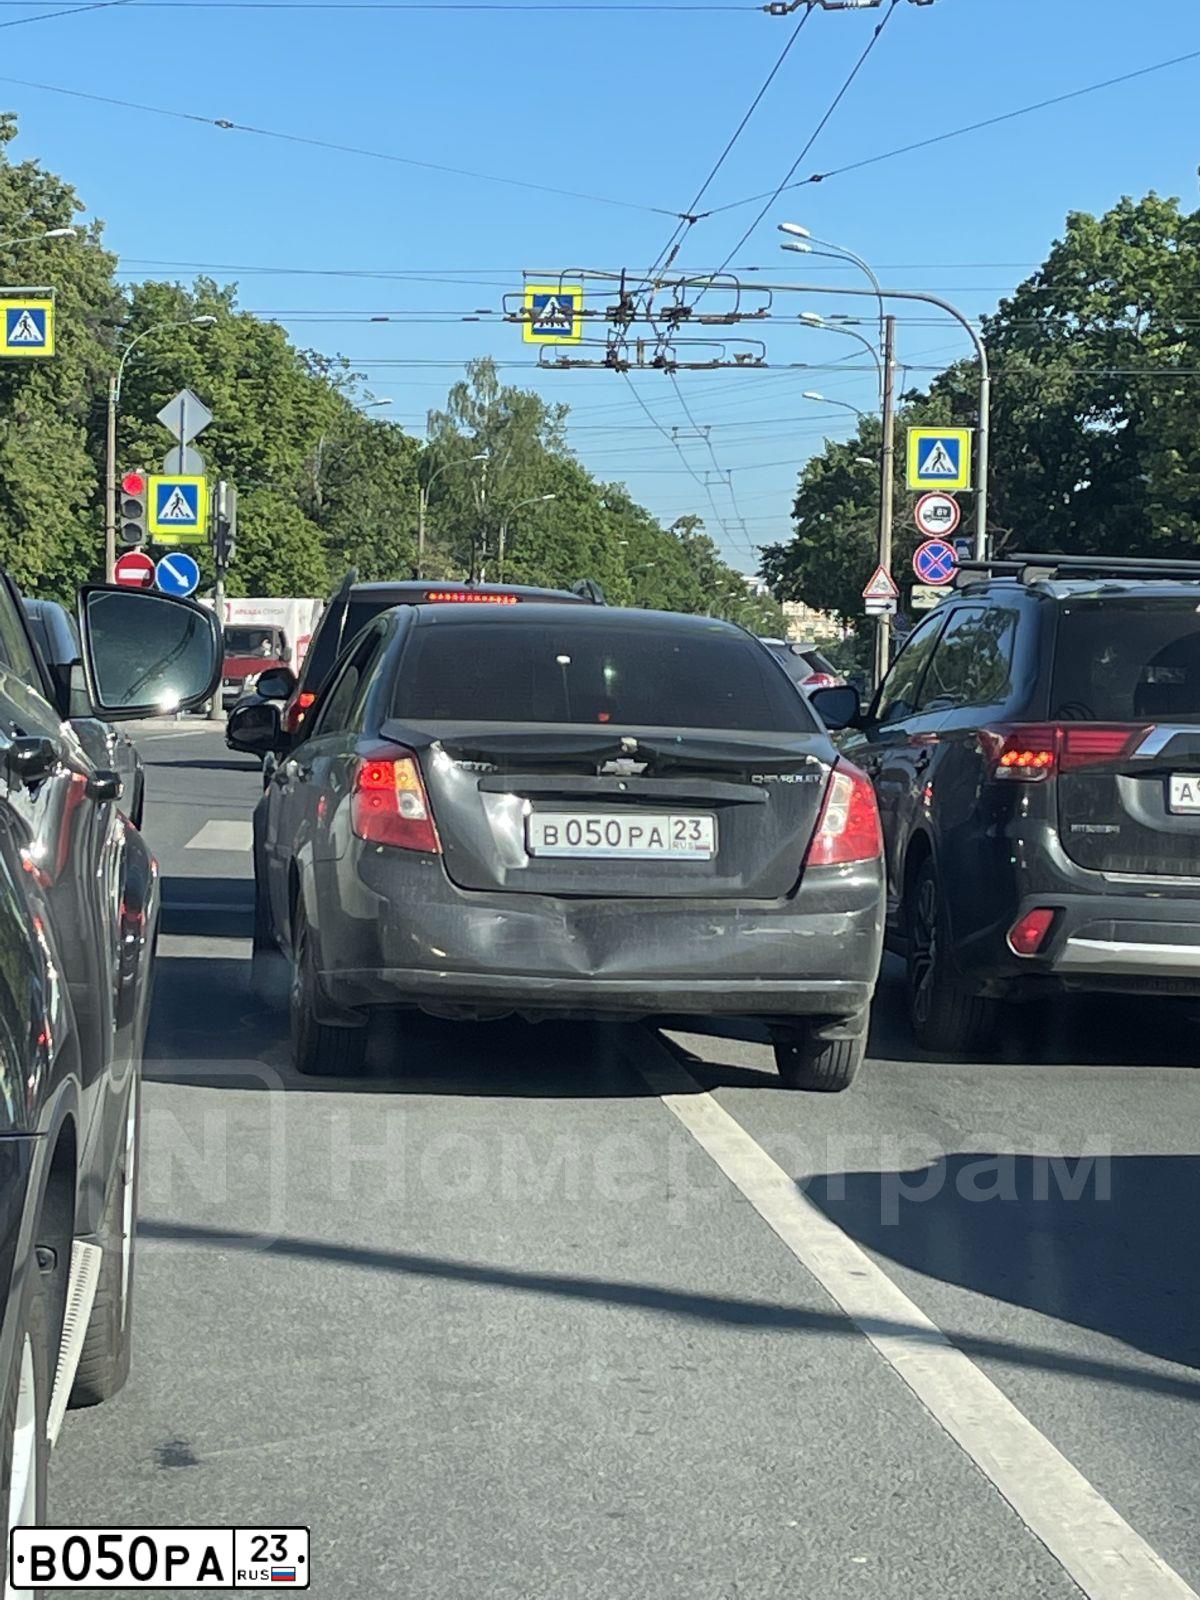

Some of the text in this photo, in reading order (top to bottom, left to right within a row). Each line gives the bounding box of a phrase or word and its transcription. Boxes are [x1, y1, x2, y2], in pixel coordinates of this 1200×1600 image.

[1180, 780, 1200, 802] А
[543, 819, 664, 848] В050РА
[673, 819, 702, 840] 23
[672, 841, 694, 849] RUS
